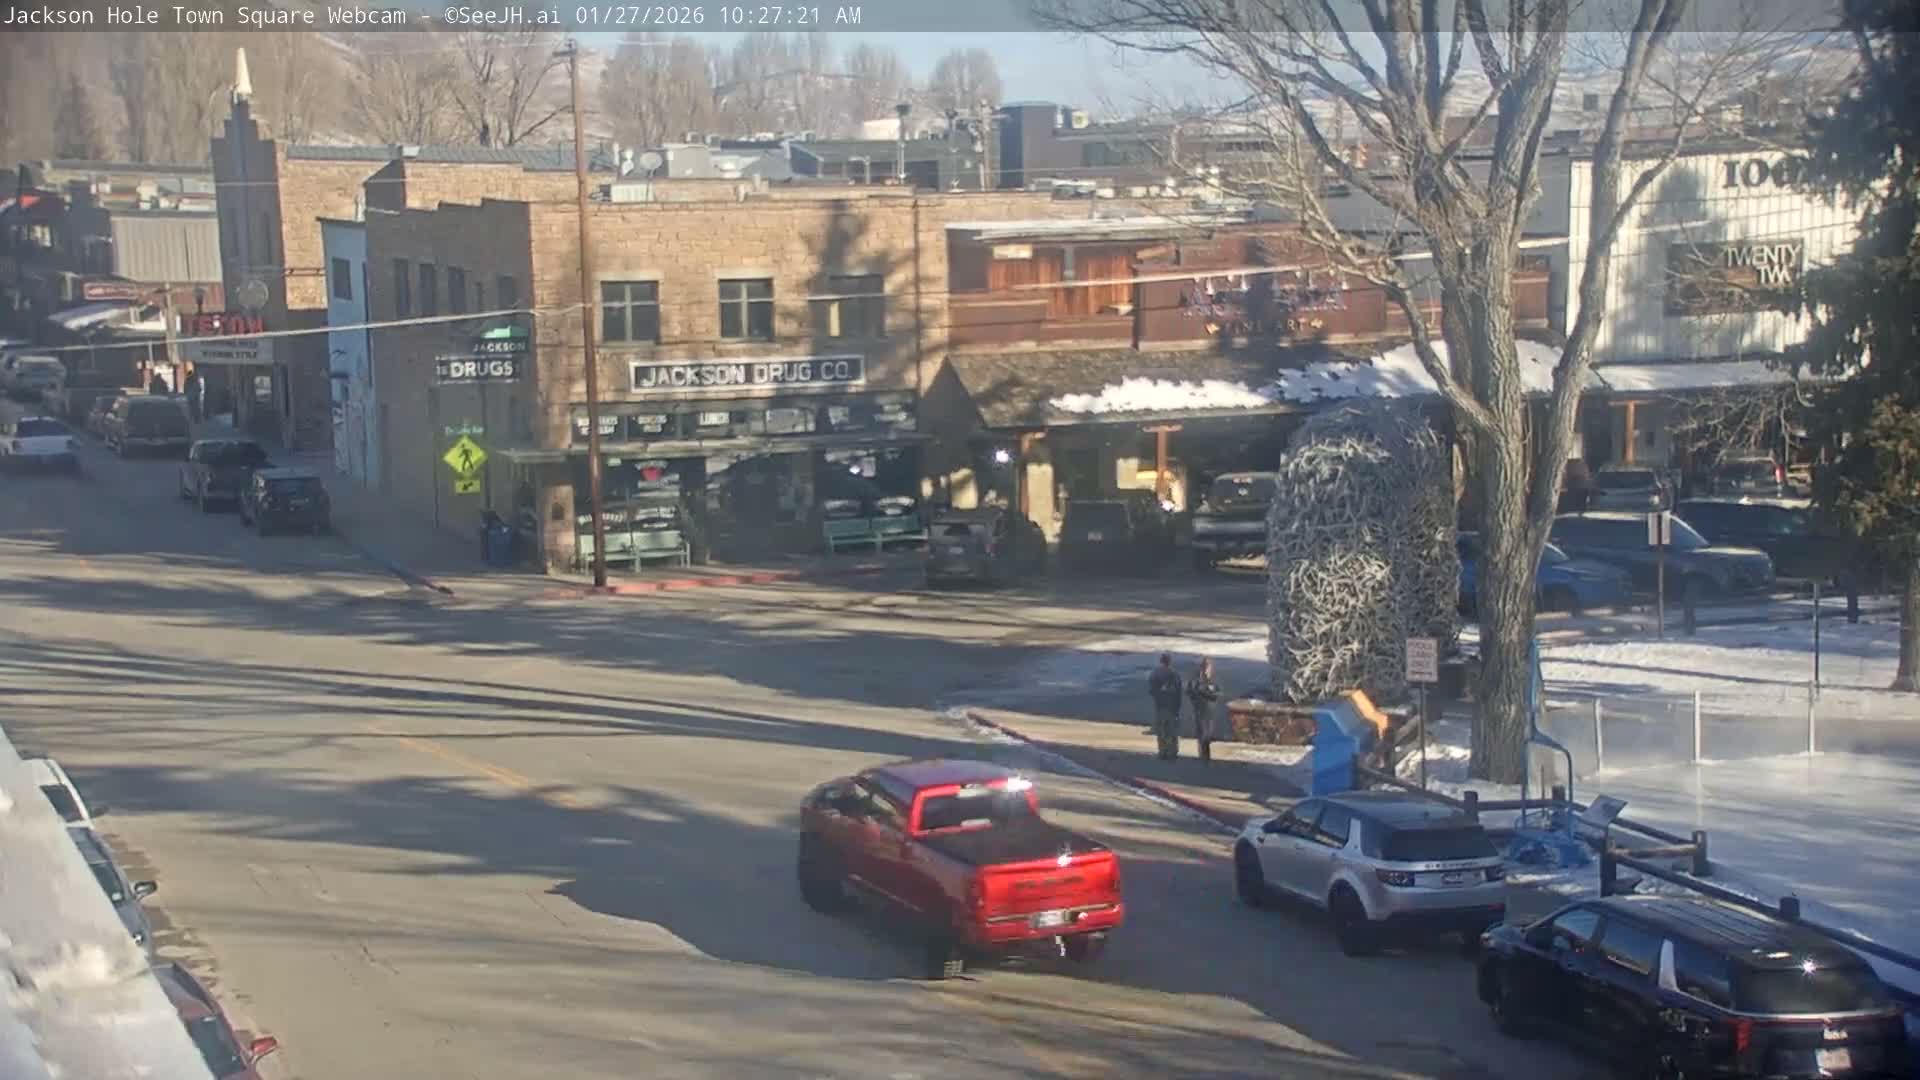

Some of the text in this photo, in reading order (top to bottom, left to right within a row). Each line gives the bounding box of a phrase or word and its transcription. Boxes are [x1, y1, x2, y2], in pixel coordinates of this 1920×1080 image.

[1722, 244, 1801, 268] TWENTY
[473, 341, 526, 353] JACKSON
[450, 359, 513, 378] DRUGS
[641, 364, 745, 388] JACKSON
[752, 361, 812, 385] DRUG
